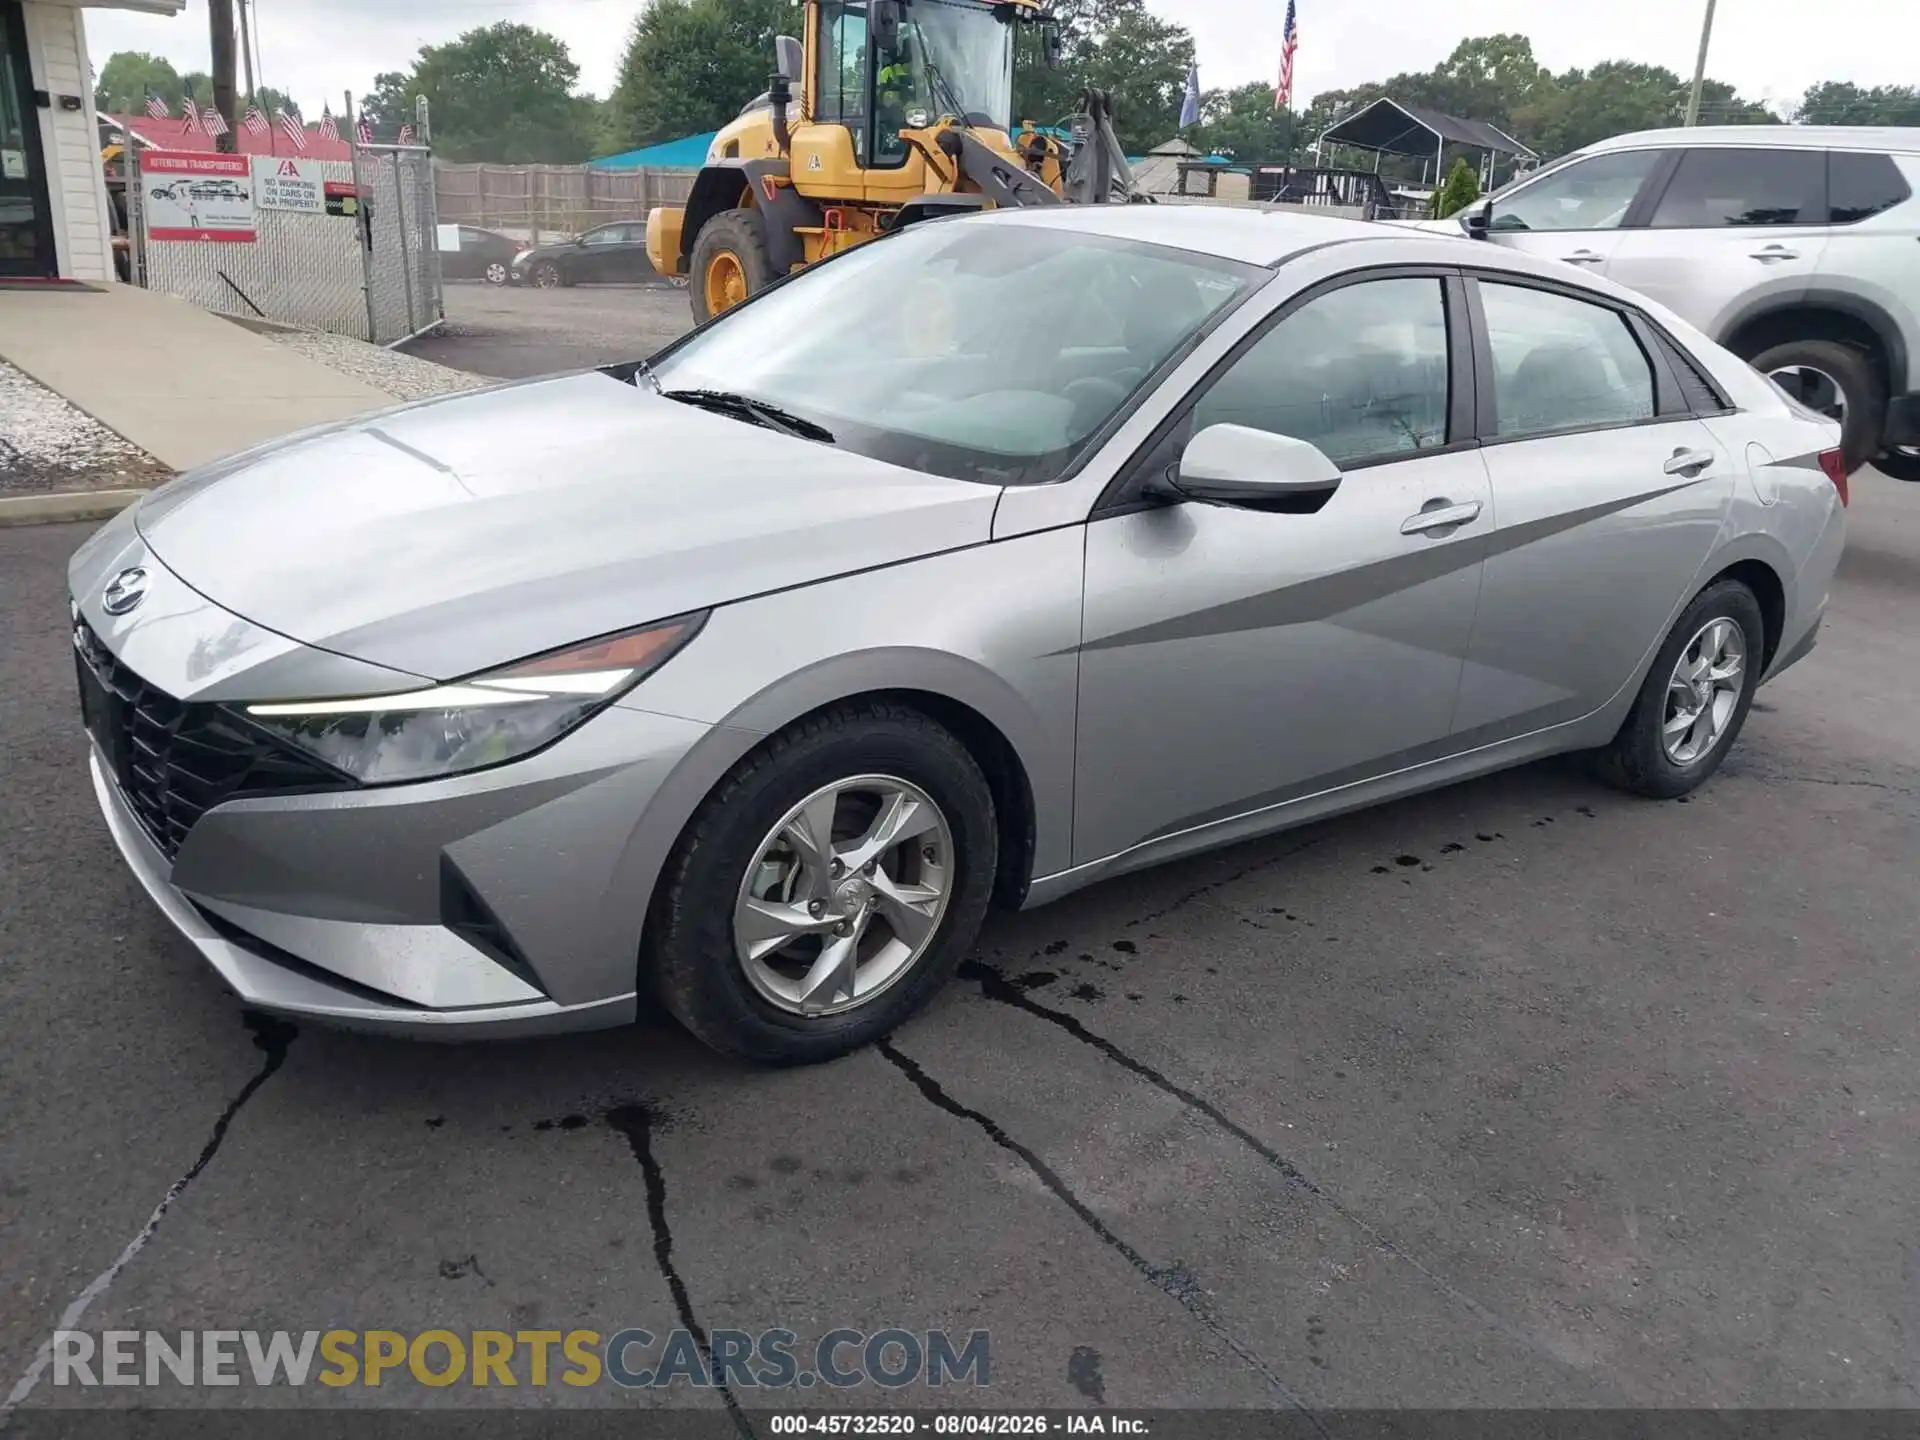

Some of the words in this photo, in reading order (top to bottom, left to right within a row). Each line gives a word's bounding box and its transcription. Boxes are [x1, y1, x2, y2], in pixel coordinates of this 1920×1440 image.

[264, 178, 276, 186] NO
[279, 180, 317, 190] WORKING
[266, 187, 278, 195] ON
[280, 188, 302, 198] CARS
[304, 190, 316, 199] ON
[279, 198, 320, 209] PROPERTY
